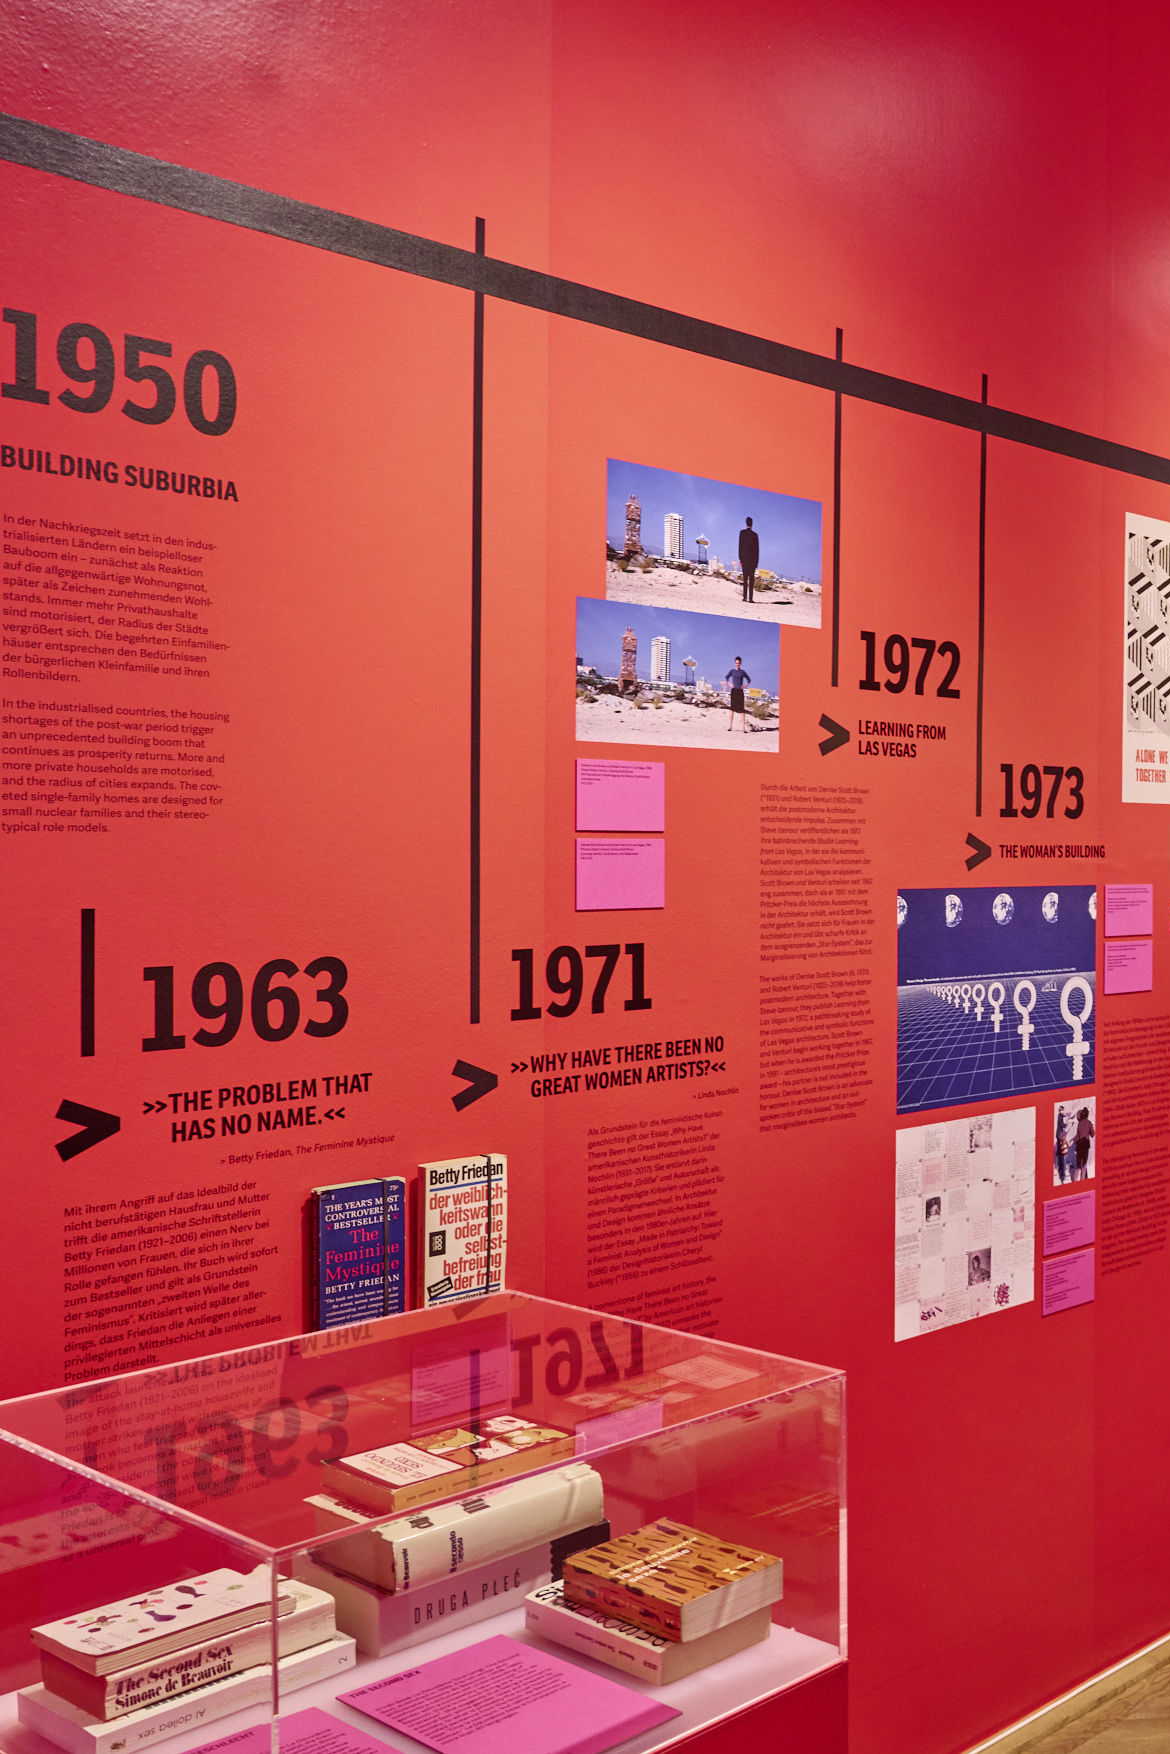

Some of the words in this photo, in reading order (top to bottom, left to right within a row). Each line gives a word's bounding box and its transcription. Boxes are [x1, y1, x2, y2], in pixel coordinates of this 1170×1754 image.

[2, 308, 236, 436] 1950
[2, 445, 118, 483] BUILDING
[125, 465, 238, 502] SUBURBIA
[3, 530, 69, 546] trialisierten
[72, 538, 116, 552] Ländern
[120, 545, 136, 554] ein
[138, 546, 203, 563] beispielloser
[4, 514, 14, 524] In
[18, 516, 36, 526] der
[40, 518, 121, 538] Nachkriegszeit
[124, 532, 150, 542] setzt
[152, 534, 162, 543] in
[164, 536, 184, 546] den
[186, 538, 216, 550] indus-
[859, 631, 960, 698] 1972
[3, 698, 13, 708] In
[16, 700, 35, 710] the
[39, 700, 113, 714] industrialised
[116, 708, 168, 718] countries,
[171, 709, 188, 718] the
[190, 710, 230, 723] housing
[859, 720, 914, 738] LEARNING
[917, 725, 946, 740] FROM
[859, 741, 879, 756] LAS
[882, 742, 916, 758] VEGAS
[1136, 749, 1156, 763] ALONE
[1159, 751, 1168, 764] WE
[1136, 768, 1166, 783] TOGETHER
[1000, 764, 1084, 819] 1973
[1000, 845, 1018, 858] THE
[1020, 845, 1063, 858] WOMAN'S
[1065, 845, 1105, 858] BUILDING
[511, 943, 652, 1021] 1971
[142, 956, 348, 1052] 1963
[572, 1048, 611, 1068] HAVE
[615, 1043, 662, 1063] THERE
[666, 1038, 700, 1057] BEEN
[706, 1036, 723, 1053] NO
[219, 1079, 316, 1108] PROBLEM
[322, 1073, 372, 1096] THAT
[532, 1076, 581, 1097] GREAT
[586, 1068, 641, 1090] WOMEN
[698, 1091, 715, 1099] Linda
[716, 1088, 739, 1096] Nochlin
[172, 1118, 215, 1143] HAS
[222, 1114, 251, 1136] NO
[229, 1154, 253, 1164] Betty
[256, 1149, 293, 1160] Friedan,
[296, 1145, 312, 1154] The
[314, 1140, 354, 1152] Feminine
[356, 1135, 395, 1147] Mystique
[430, 1168, 460, 1185] Betty
[64, 1221, 92, 1232] nicht
[96, 1210, 166, 1227] berufstätigen
[169, 1202, 214, 1216] Hausfrau
[217, 1197, 235, 1208] und
[238, 1194, 270, 1204] Mutter
[65, 1207, 82, 1216] Mit
[86, 1204, 116, 1214] ihrem
[120, 1195, 155, 1209] Angriff
[158, 1192, 174, 1203] auf
[176, 1192, 194, 1200] das
[197, 1183, 238, 1197] Idealbild
[241, 1181, 256, 1190] der
[325, 1204, 342, 1213] THE
[325, 1204, 399, 1222] CONTROVERSAL
[430, 1193, 450, 1210] der
[349, 1228, 379, 1244] The
[455, 1222, 482, 1240] oder
[325, 1282, 356, 1294] BETTY
[454, 1274, 474, 1291] der
[414, 1590, 468, 1624] DRUGA
[115, 1677, 144, 1696] The
[147, 1652, 202, 1684] Second
[206, 1645, 233, 1663] Sex
[115, 1686, 162, 1711] Simone
[165, 1679, 178, 1692] de
[181, 1659, 233, 1687] Beauvoir
[191, 1731, 254, 1754] SCHLECHT
